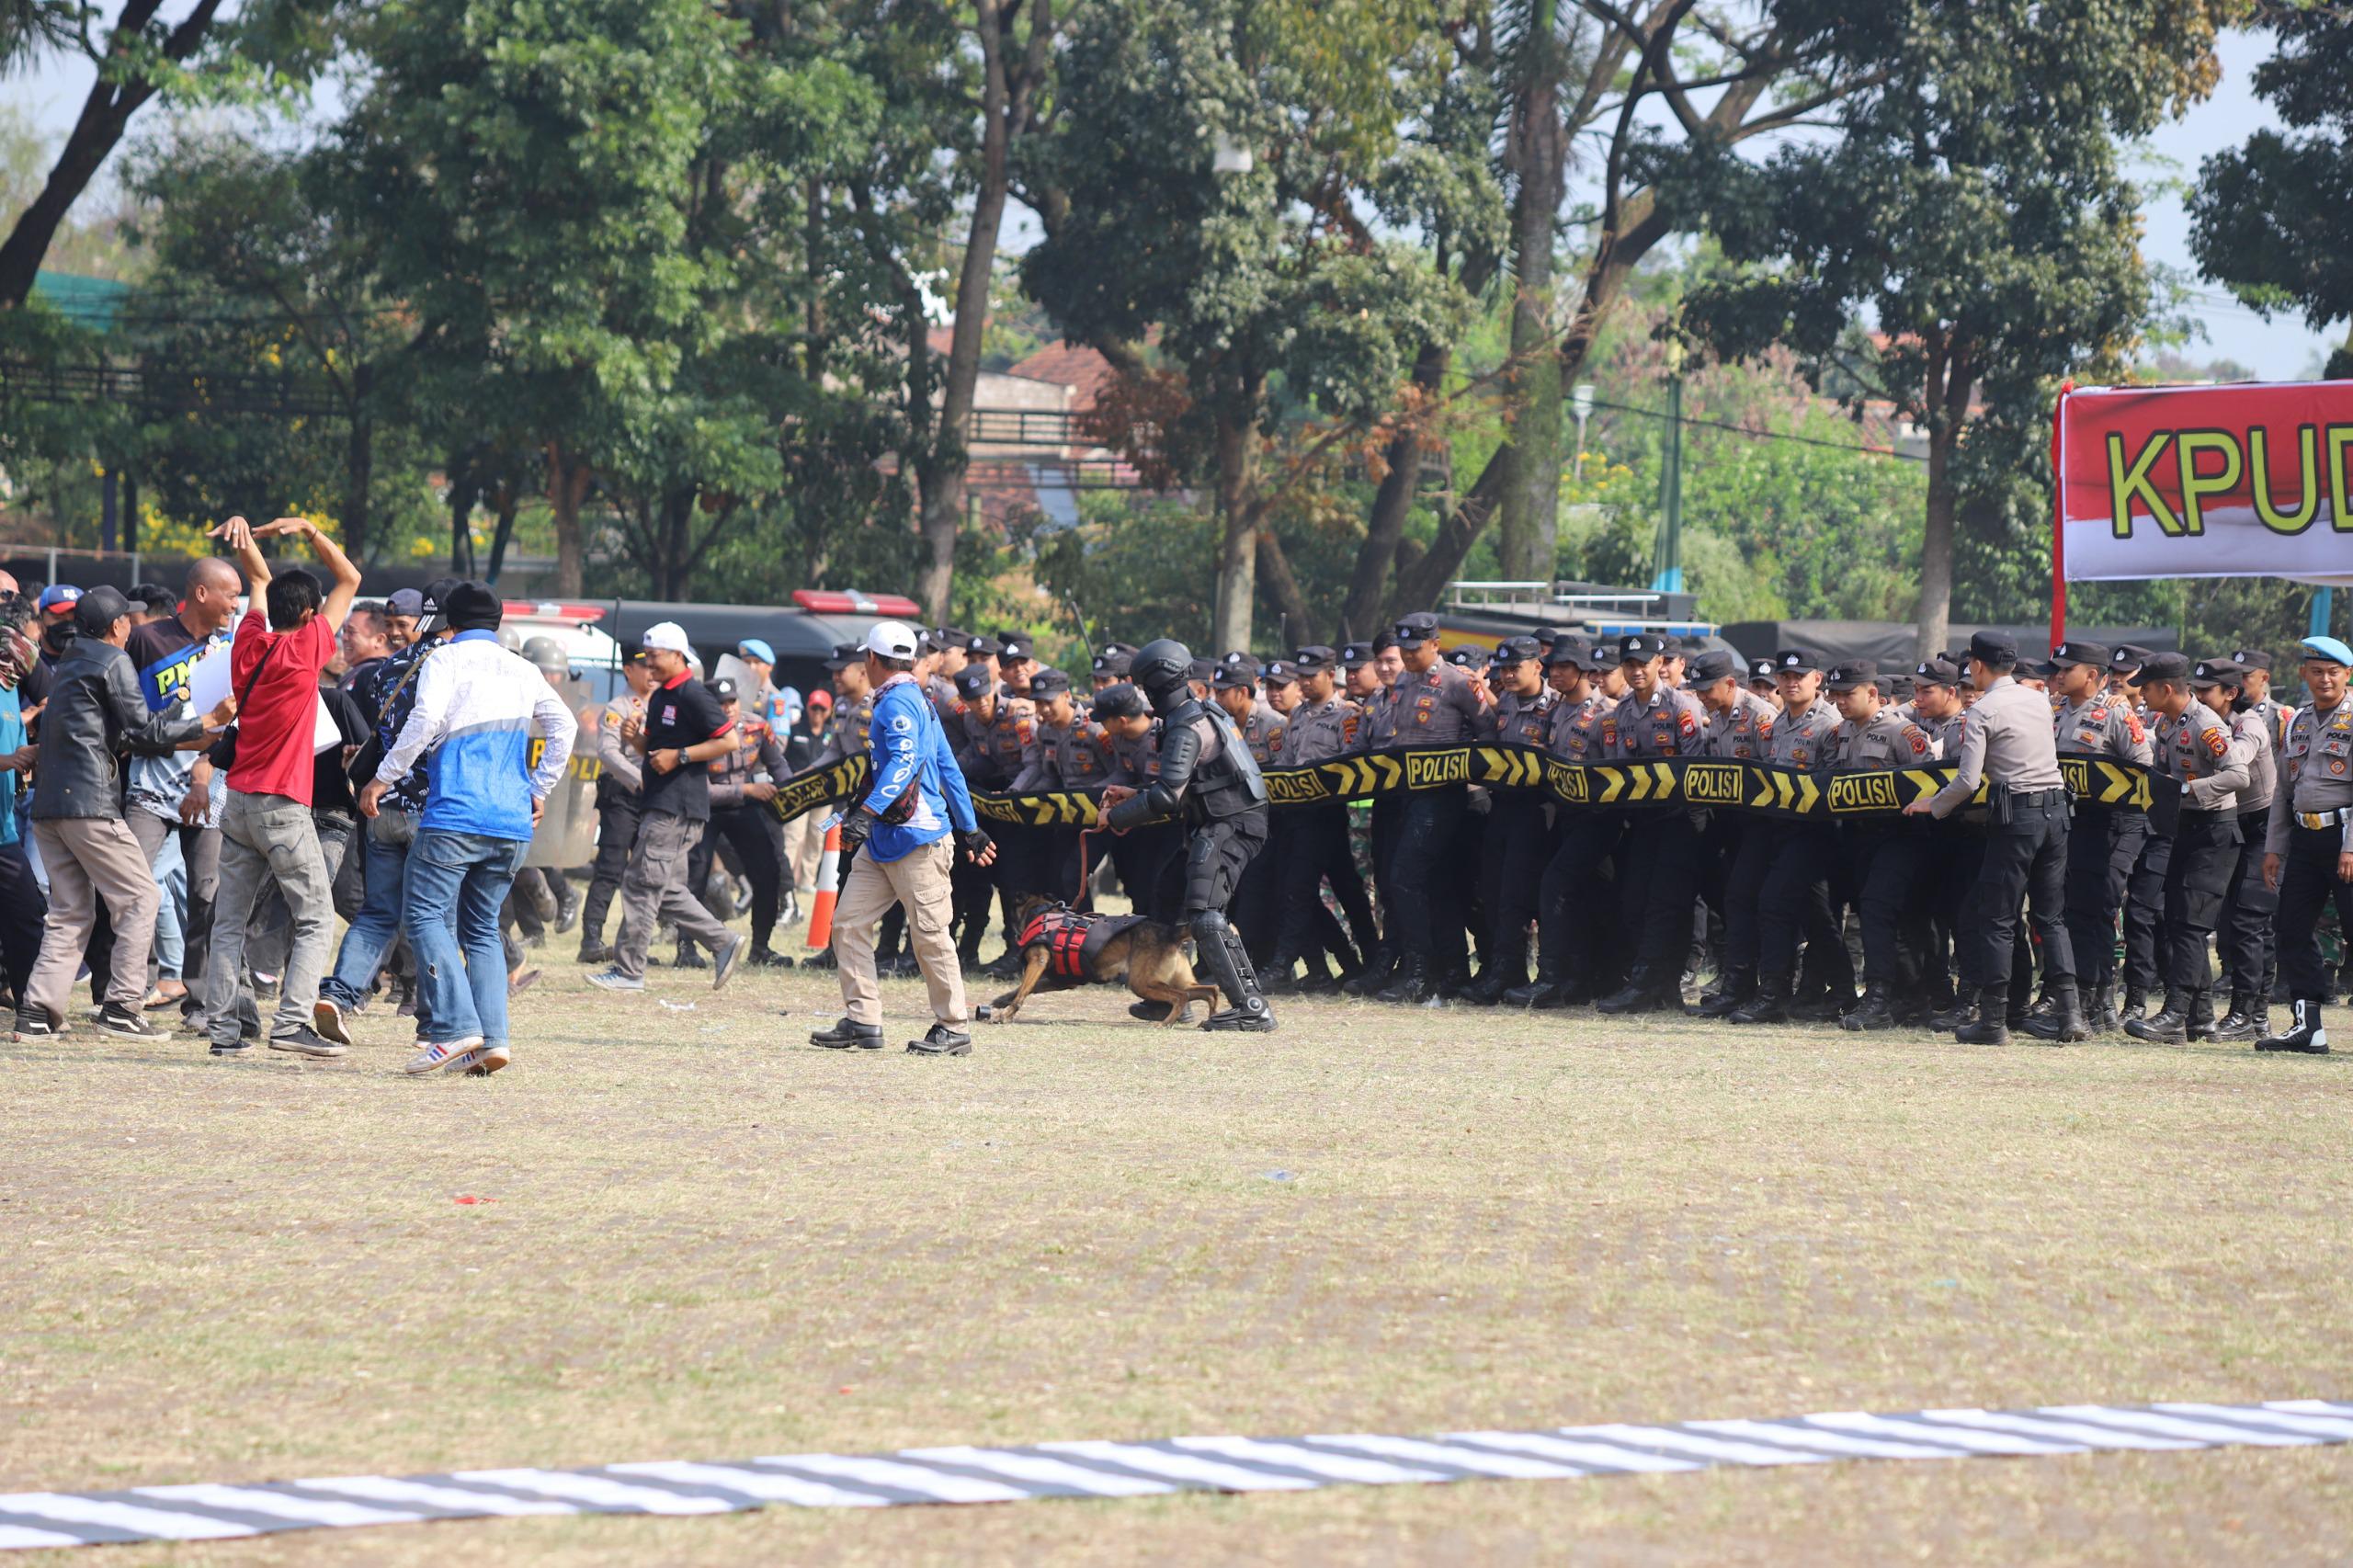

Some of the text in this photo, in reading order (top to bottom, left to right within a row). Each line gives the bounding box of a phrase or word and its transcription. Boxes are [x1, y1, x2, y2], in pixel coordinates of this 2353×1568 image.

[1316, 722, 1339, 733] POLRI
[1733, 735, 1752, 744] POLRI
[1794, 738, 1814, 748] POLRI
[1867, 733, 1888, 744] POLRI
[2325, 732, 2352, 742] POLRI
[1411, 754, 1466, 783] POLISI
[1266, 773, 1322, 799] POLISI
[1688, 769, 1738, 798] POLISI
[1831, 778, 1894, 806] POLISI
[972, 799, 1024, 824] OLISI
